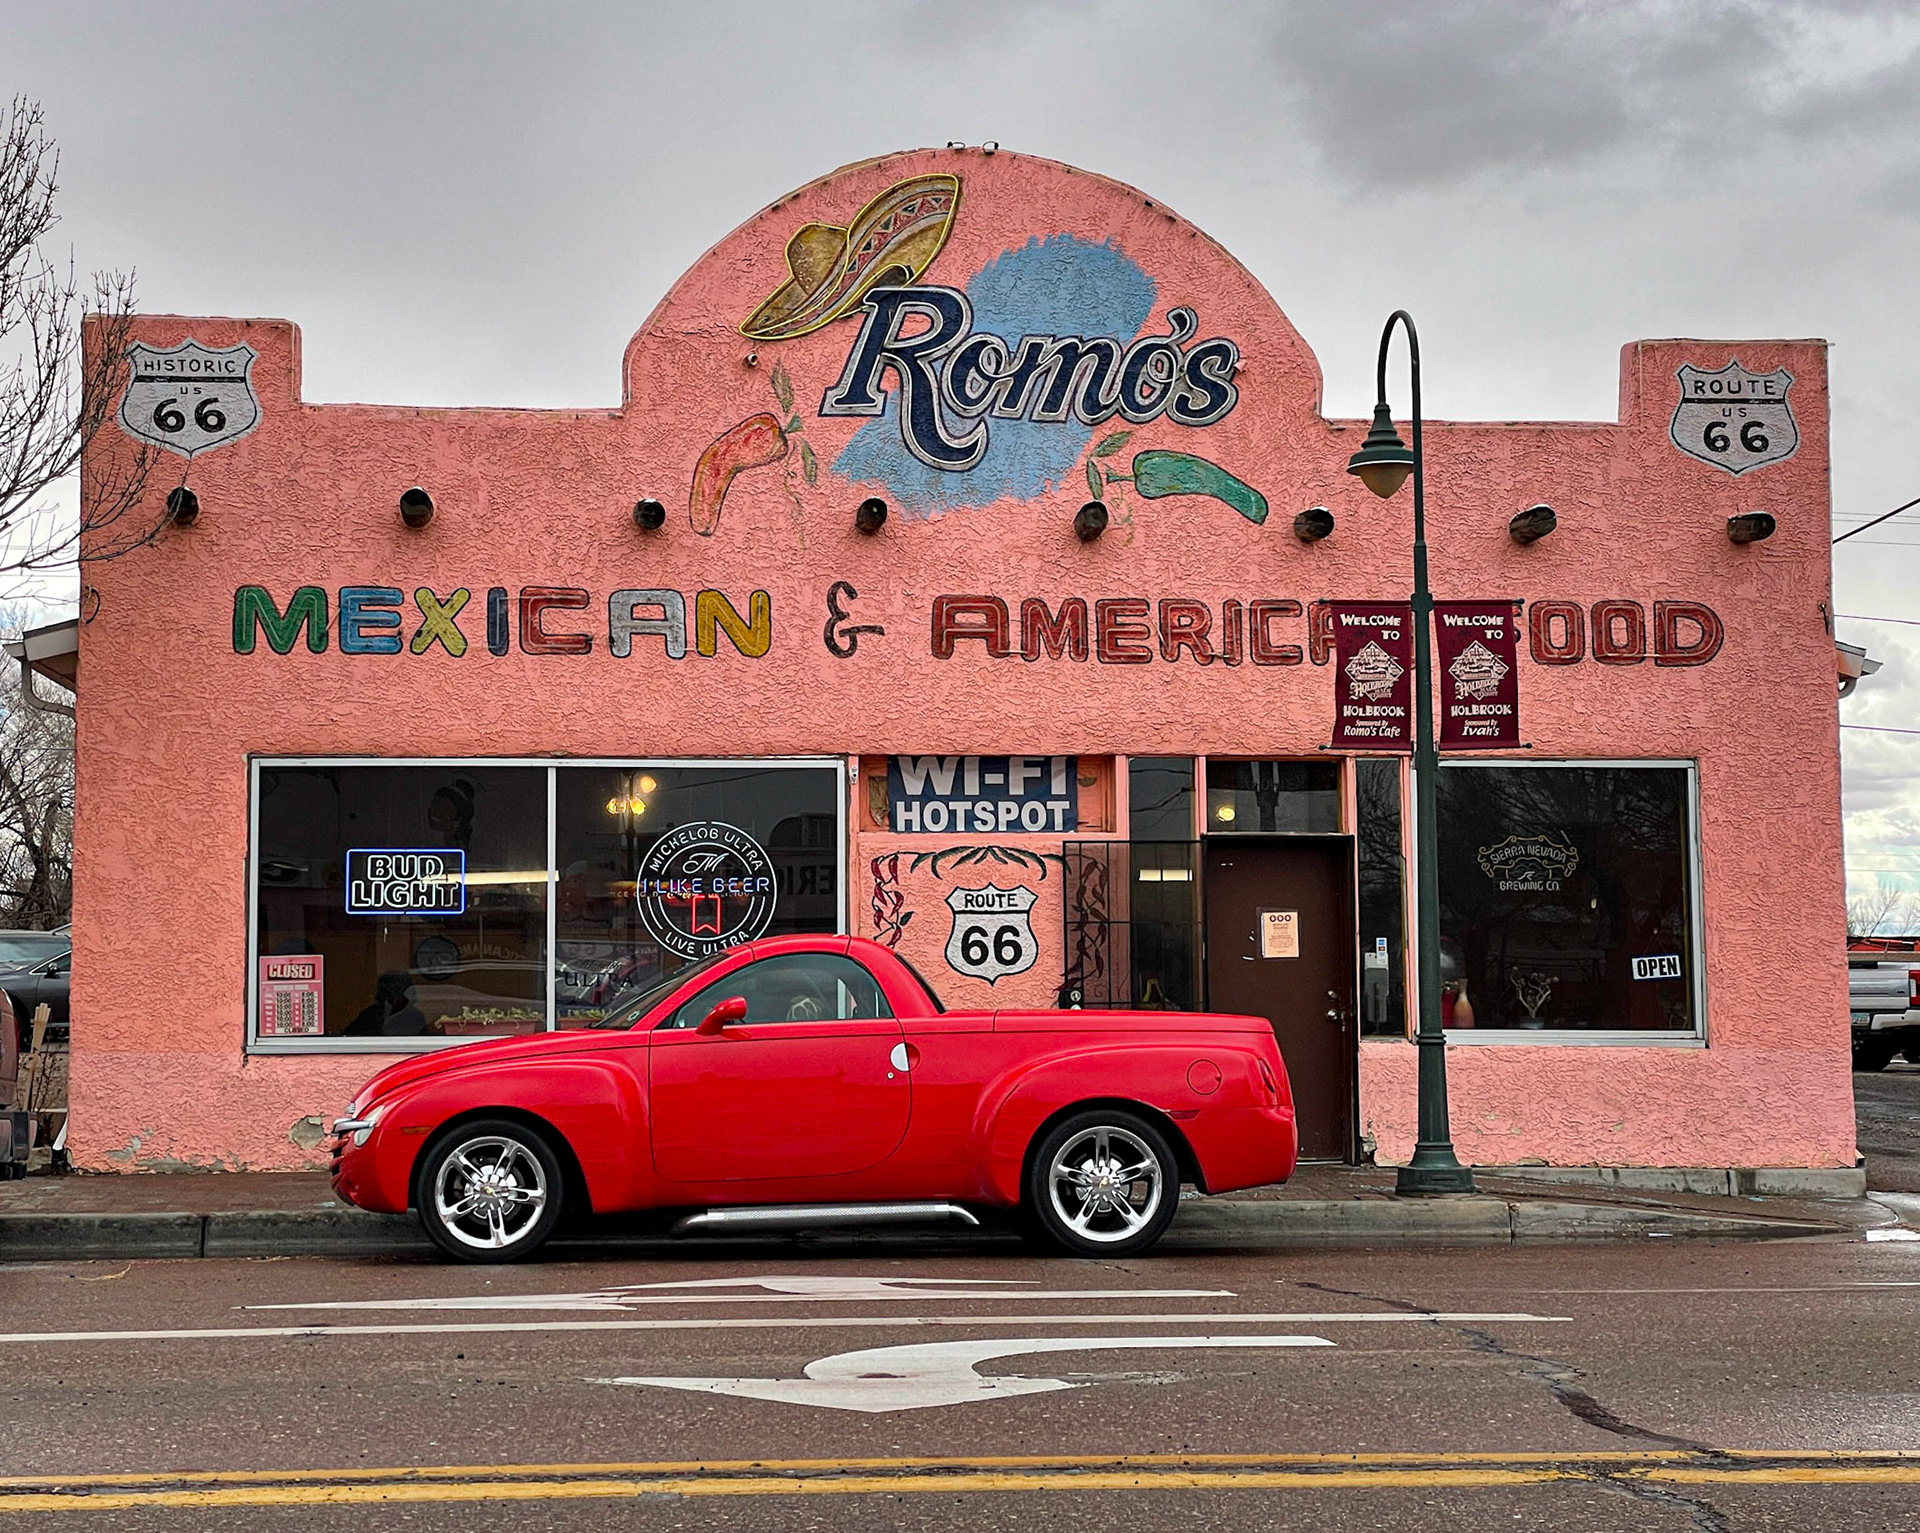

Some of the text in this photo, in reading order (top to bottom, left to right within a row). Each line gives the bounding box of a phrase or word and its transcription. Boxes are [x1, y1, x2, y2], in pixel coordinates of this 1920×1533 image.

[144, 359, 236, 373] HISTORIC
[819, 285, 1243, 471] Romo's
[180, 386, 202, 395] US
[1694, 380, 1776, 395] ROUTE
[153, 397, 226, 433] 66
[1722, 407, 1747, 417] US
[1703, 421, 1769, 453] 66
[233, 581, 1724, 668] MEXICAN & AMERIC OOD
[1340, 613, 1401, 626] WELCOME
[1443, 614, 1504, 626] WELCOME
[1381, 629, 1400, 640] TO
[1485, 629, 1503, 639] TO
[1343, 705, 1405, 717] HOLBROOK
[1450, 704, 1512, 717] HOLBROOK
[1344, 726, 1401, 738] Romo's Cafe
[1462, 726, 1500, 737] Ivah's
[897, 756, 1068, 796] WI-FI
[896, 801, 1070, 832] HOTSPOT
[649, 828, 763, 872] MICHELOB ULTRA
[1490, 845, 1567, 864] SIERRA NEVADA
[367, 855, 444, 881] BUD
[643, 877, 770, 893] I LIKE BEER
[1500, 881, 1543, 891] BREWING
[352, 881, 459, 908] LIGHT
[964, 893, 1018, 908] ROUTE
[665, 932, 696, 954] LIVE
[961, 925, 1023, 966] 66
[269, 964, 313, 978] CLOSED
[1636, 957, 1678, 978] OPEN
[564, 971, 634, 987] ULTA
